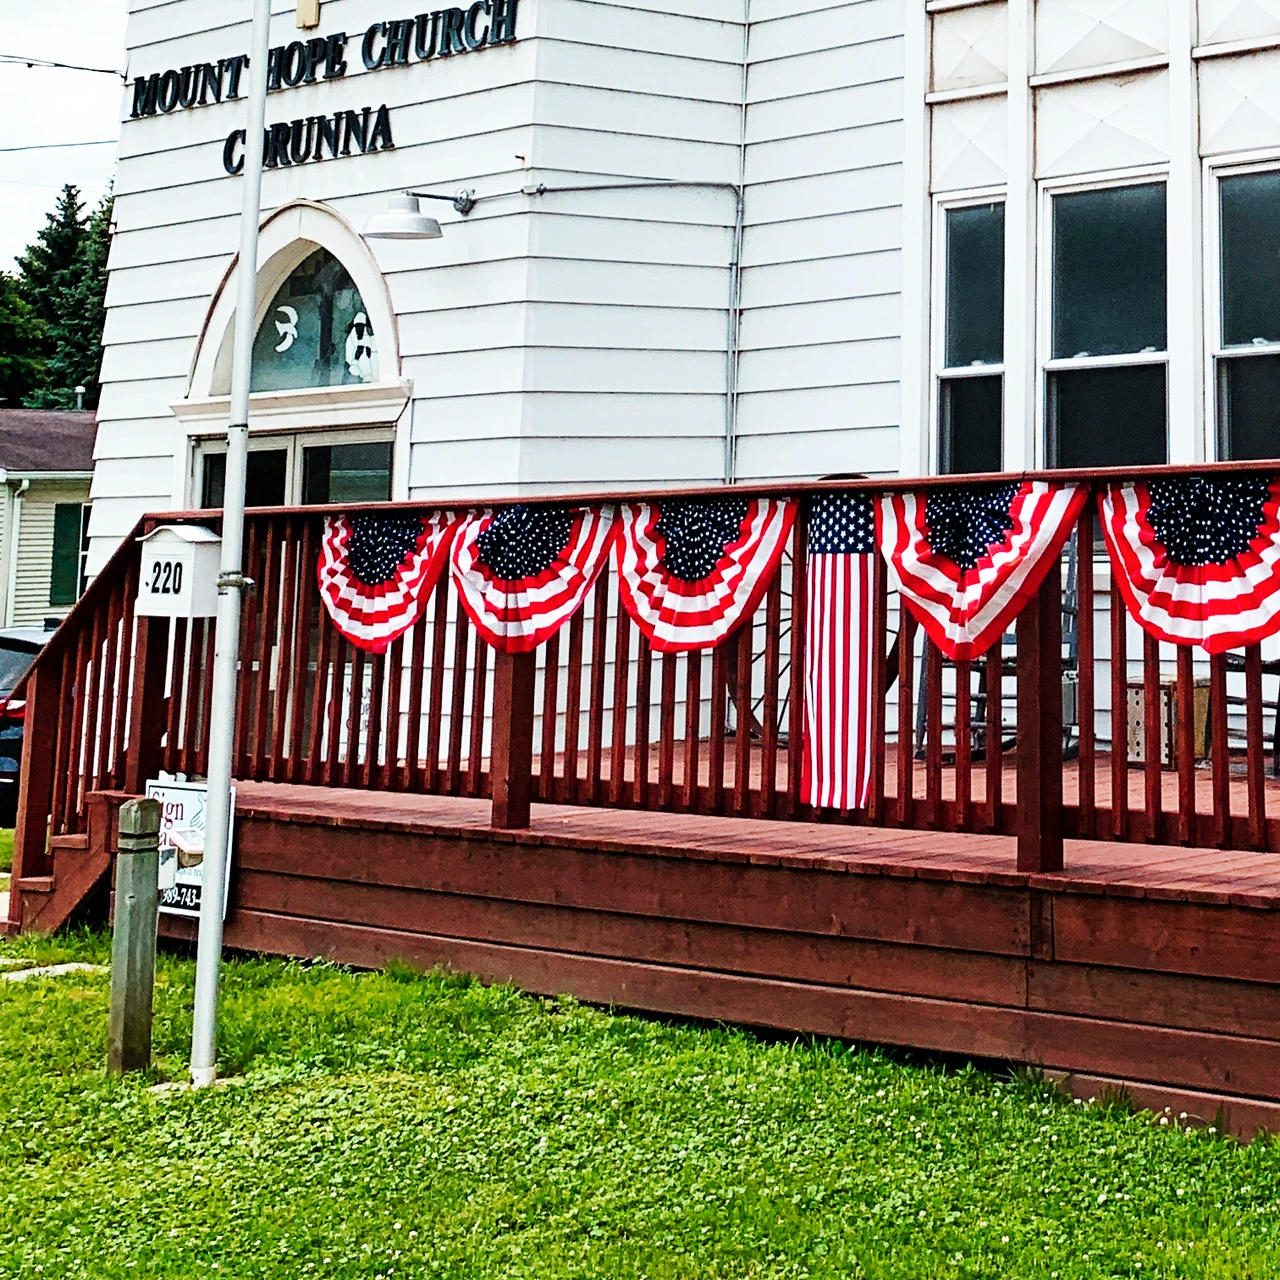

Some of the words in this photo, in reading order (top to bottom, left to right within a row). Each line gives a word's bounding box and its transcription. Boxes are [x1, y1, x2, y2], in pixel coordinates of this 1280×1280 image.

[130, 54, 250, 118] MOUNT
[266, 32, 348, 91] HOPE
[151, 561, 183, 595] 220
